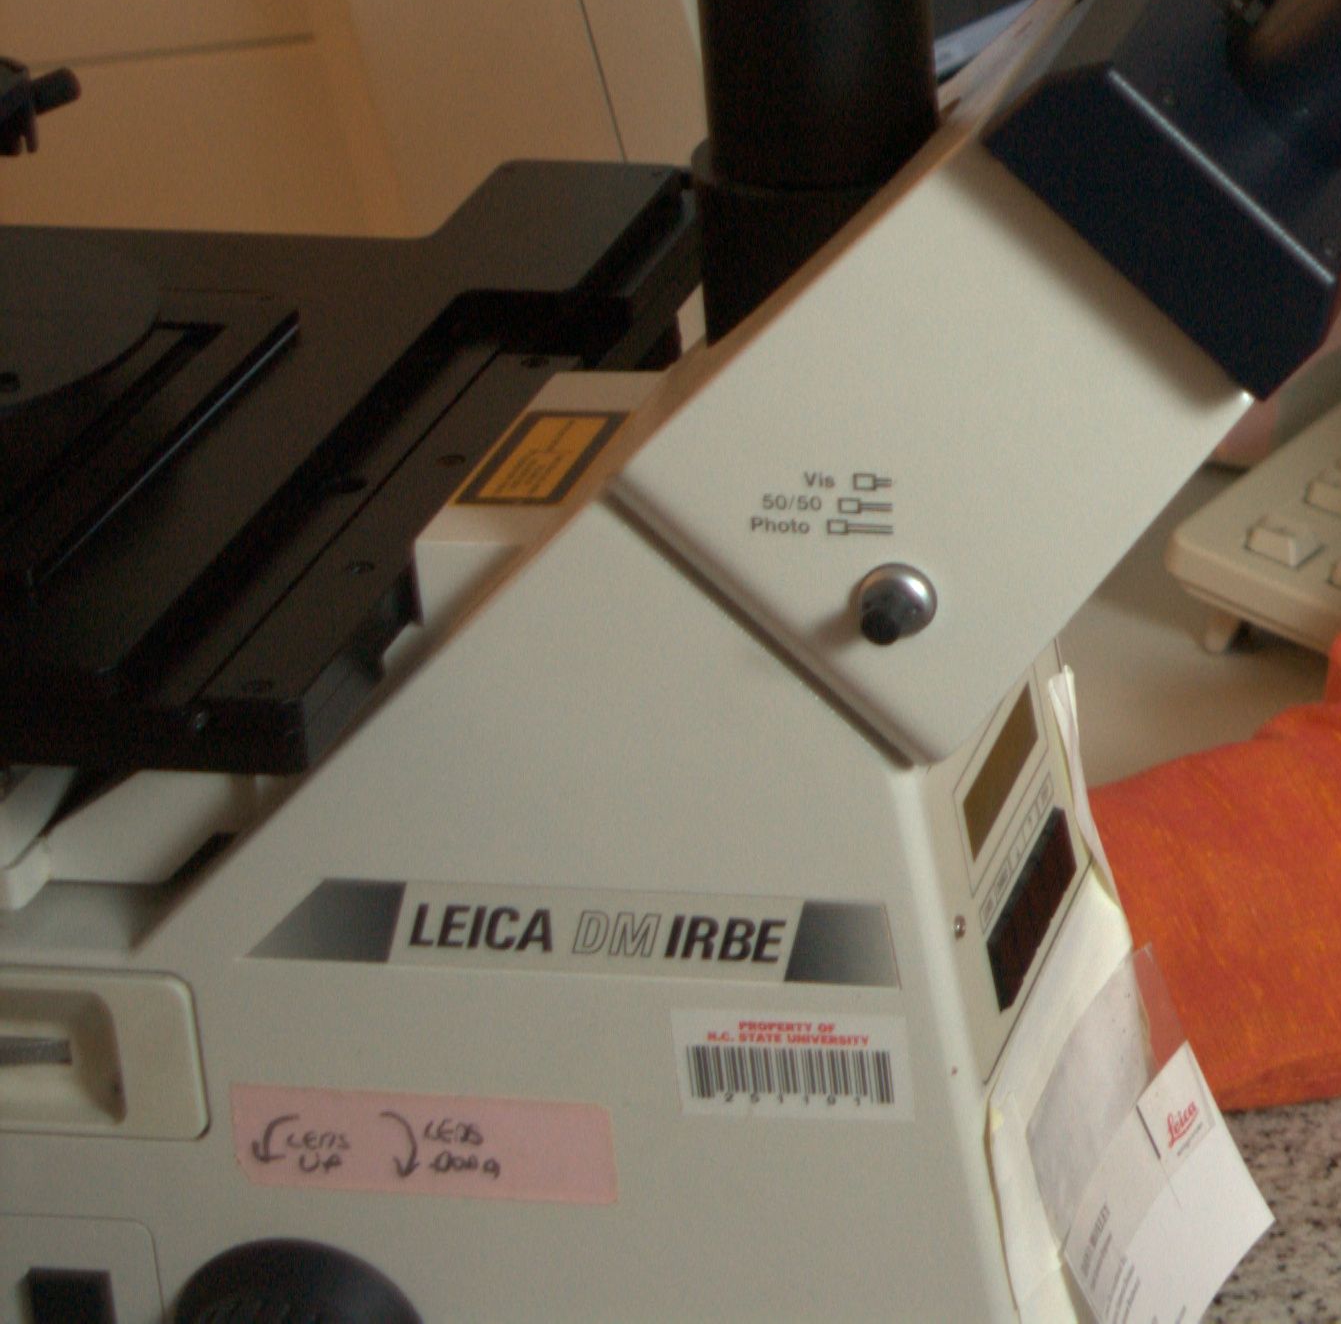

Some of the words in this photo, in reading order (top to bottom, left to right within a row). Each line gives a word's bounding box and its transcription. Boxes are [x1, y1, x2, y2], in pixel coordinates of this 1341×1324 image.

[803, 471, 836, 488] Vis
[761, 492, 823, 511] 50/50
[750, 516, 811, 535] Photo
[408, 902, 553, 953] LEICA
[571, 908, 662, 957] DM
[663, 913, 787, 964] IRBE
[738, 1020, 812, 1032] PROPERTY
[817, 1022, 836, 1033] OF
[738, 1032, 782, 1044] STATE
[787, 1034, 869, 1046] UNIVERSITY
[1166, 1101, 1200, 1150] Leica
